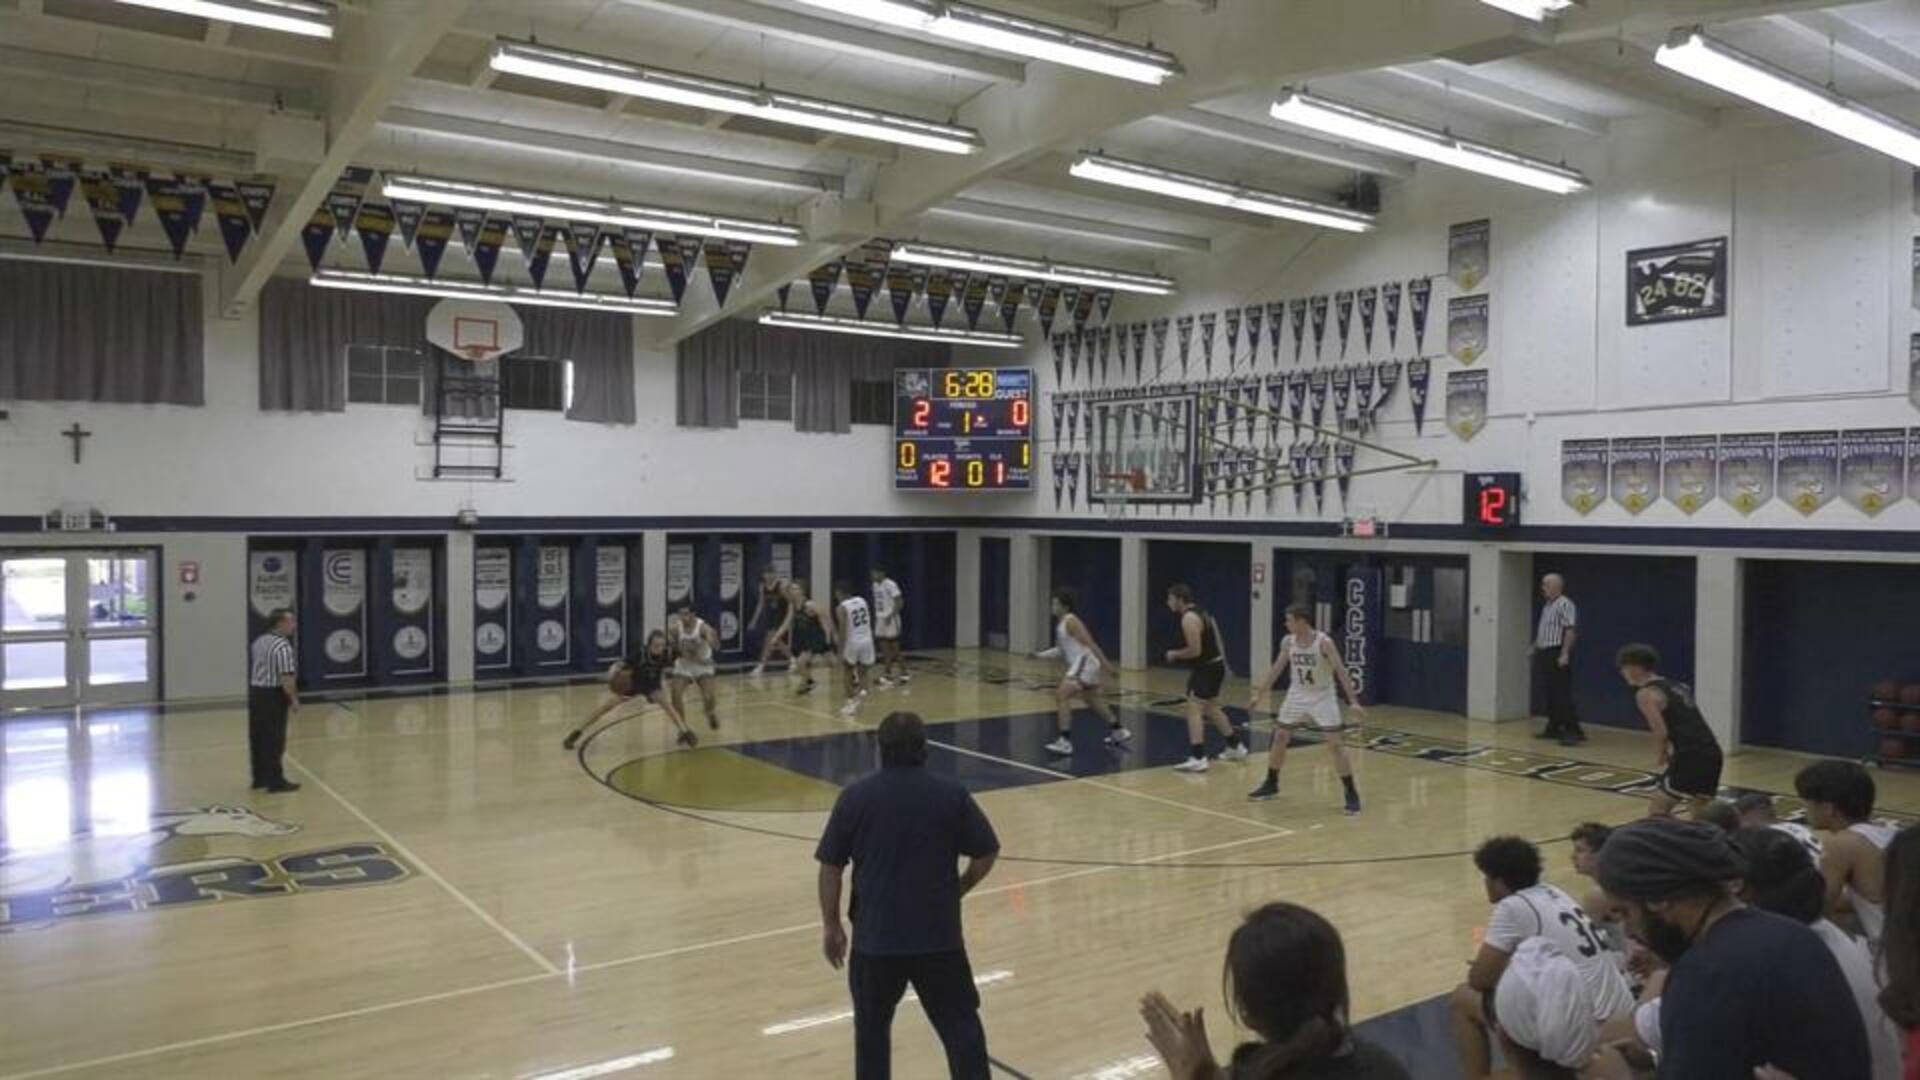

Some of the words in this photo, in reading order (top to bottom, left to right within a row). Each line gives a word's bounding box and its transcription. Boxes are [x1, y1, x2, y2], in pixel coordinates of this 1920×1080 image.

[944, 371, 994, 397] 6:28
[914, 400, 930, 426] 2
[963, 411, 970, 433] 1
[1013, 400, 1029, 426] 0
[900, 442, 916, 468] 0
[1022, 443, 1029, 466] 1
[930, 461, 951, 487] 12
[967, 461, 984, 487] 0
[997, 462, 1004, 485] 1
[1480, 487, 1505, 523] 12
[851, 607, 869, 627] 22
[1344, 577, 1367, 695] CCHS
[1296, 667, 1316, 685] 14
